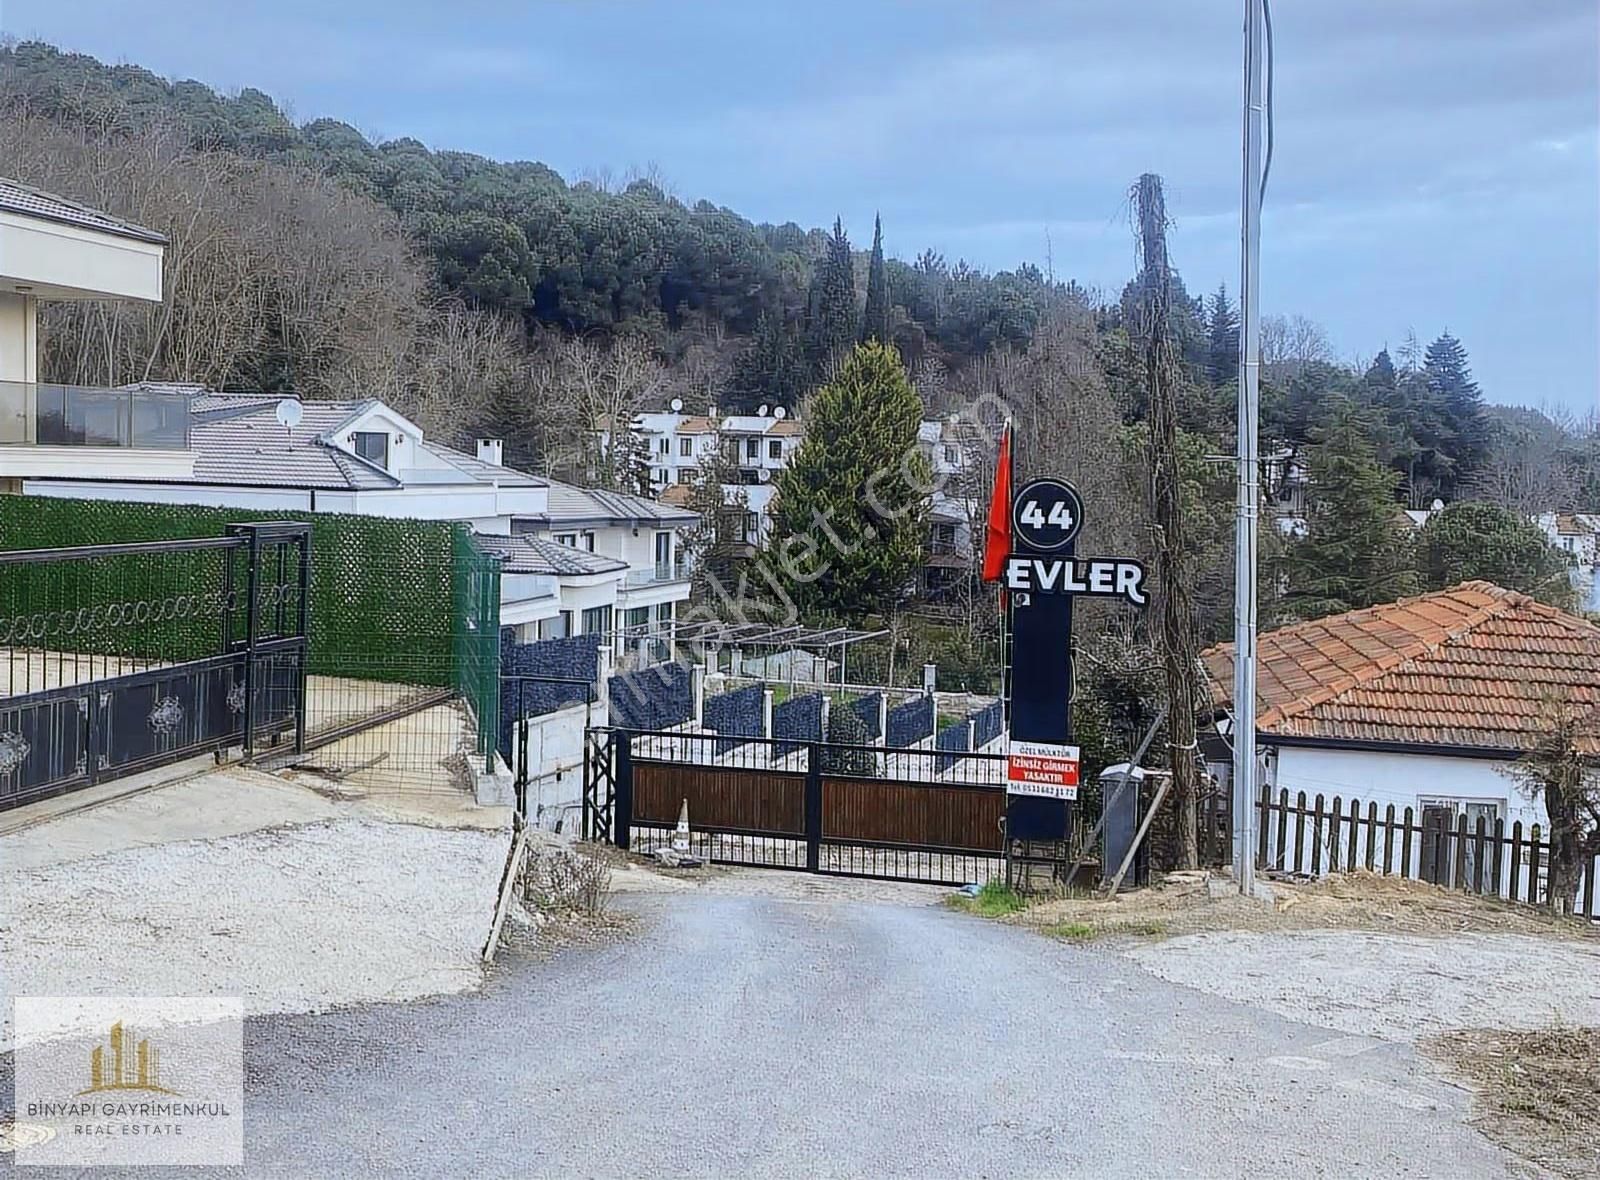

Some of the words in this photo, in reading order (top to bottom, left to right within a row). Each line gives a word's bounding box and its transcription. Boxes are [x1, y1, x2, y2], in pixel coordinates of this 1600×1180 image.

[1020, 500, 1073, 530] 44
[1006, 558, 1145, 604] EVLER
[1023, 770, 1064, 783] YASAKTIR
[1042, 760, 1076, 773] GİRMEK
